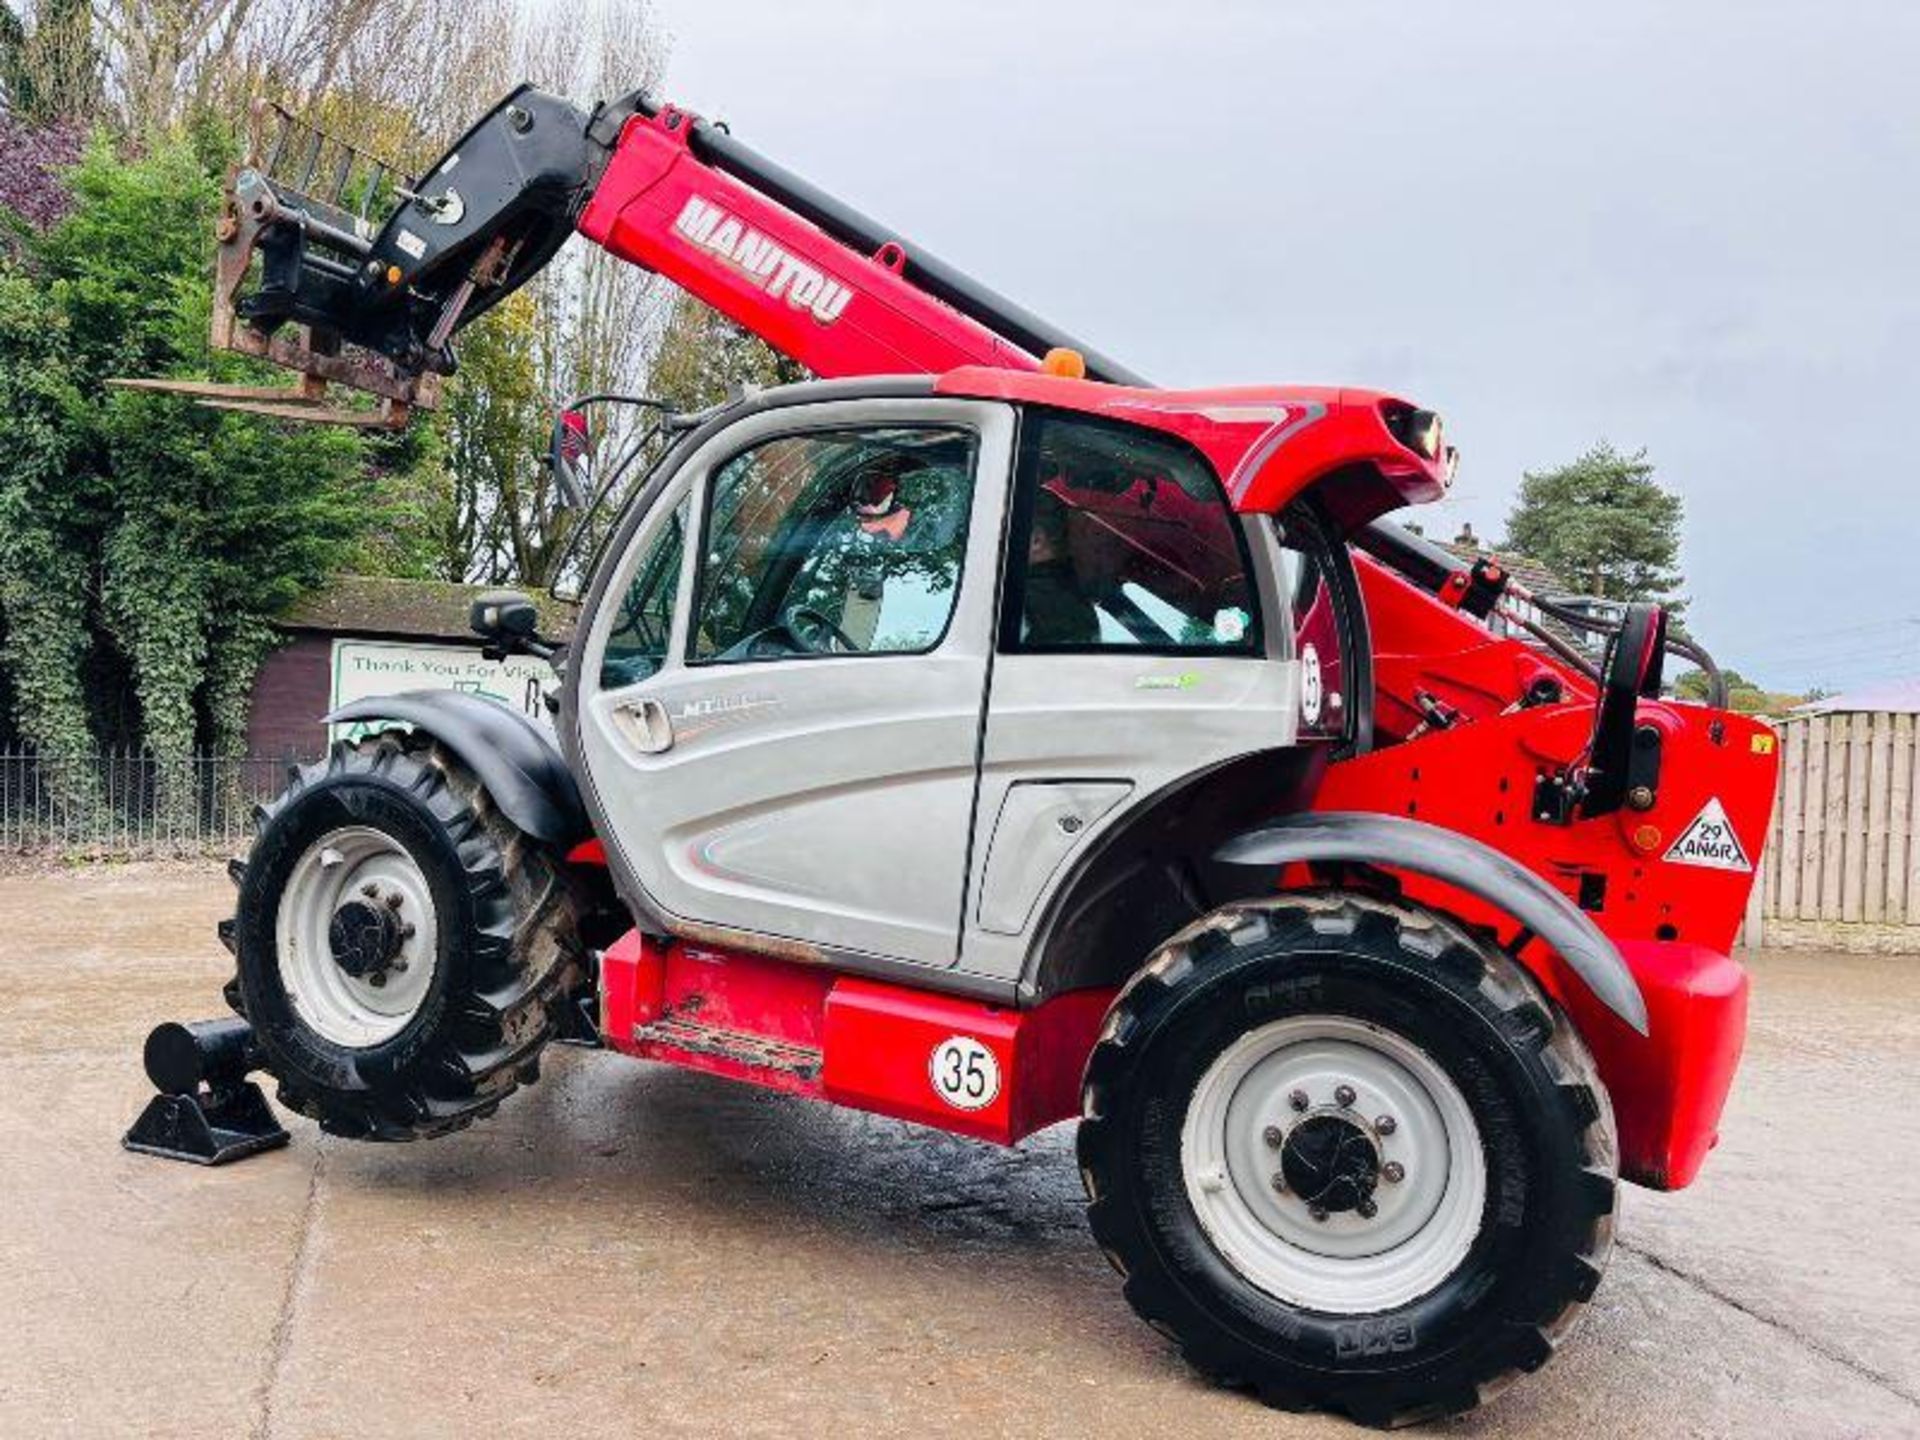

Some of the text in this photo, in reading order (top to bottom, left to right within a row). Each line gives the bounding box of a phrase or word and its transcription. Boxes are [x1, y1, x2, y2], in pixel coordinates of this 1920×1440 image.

[675, 194, 854, 324] MANITOU
[353, 657, 415, 673] Thank
[421, 661, 460, 676] You
[466, 664, 496, 678] For
[1699, 824, 1722, 841] 29
[943, 1047, 985, 1098] 35
